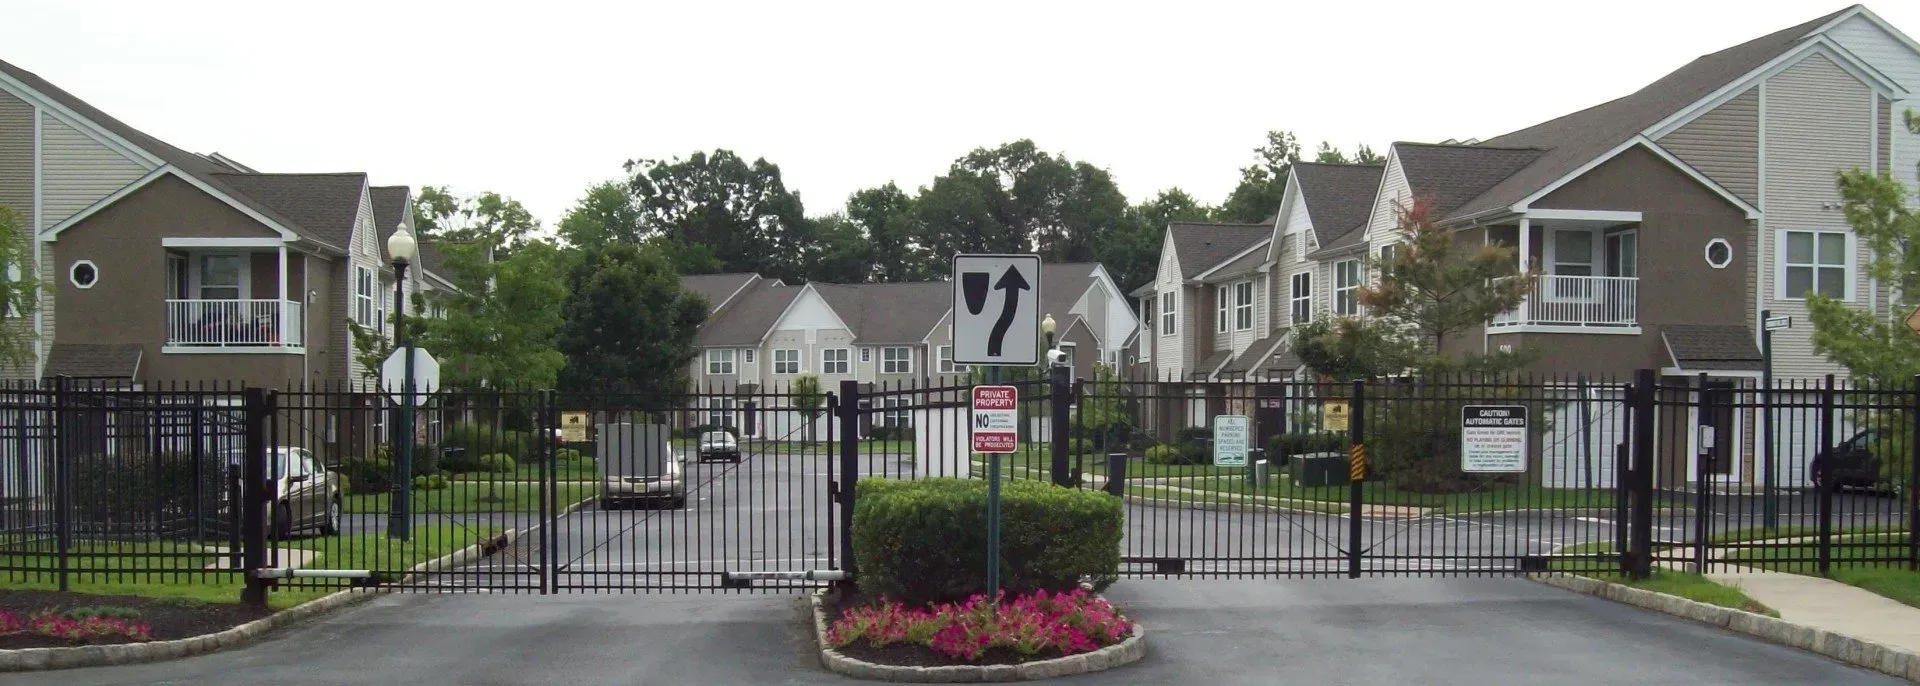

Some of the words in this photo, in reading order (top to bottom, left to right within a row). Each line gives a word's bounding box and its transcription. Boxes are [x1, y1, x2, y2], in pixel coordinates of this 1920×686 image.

[980, 390, 1010, 398] PRIVATE
[975, 399, 1014, 407] PROPERTY
[975, 413, 990, 428] NO
